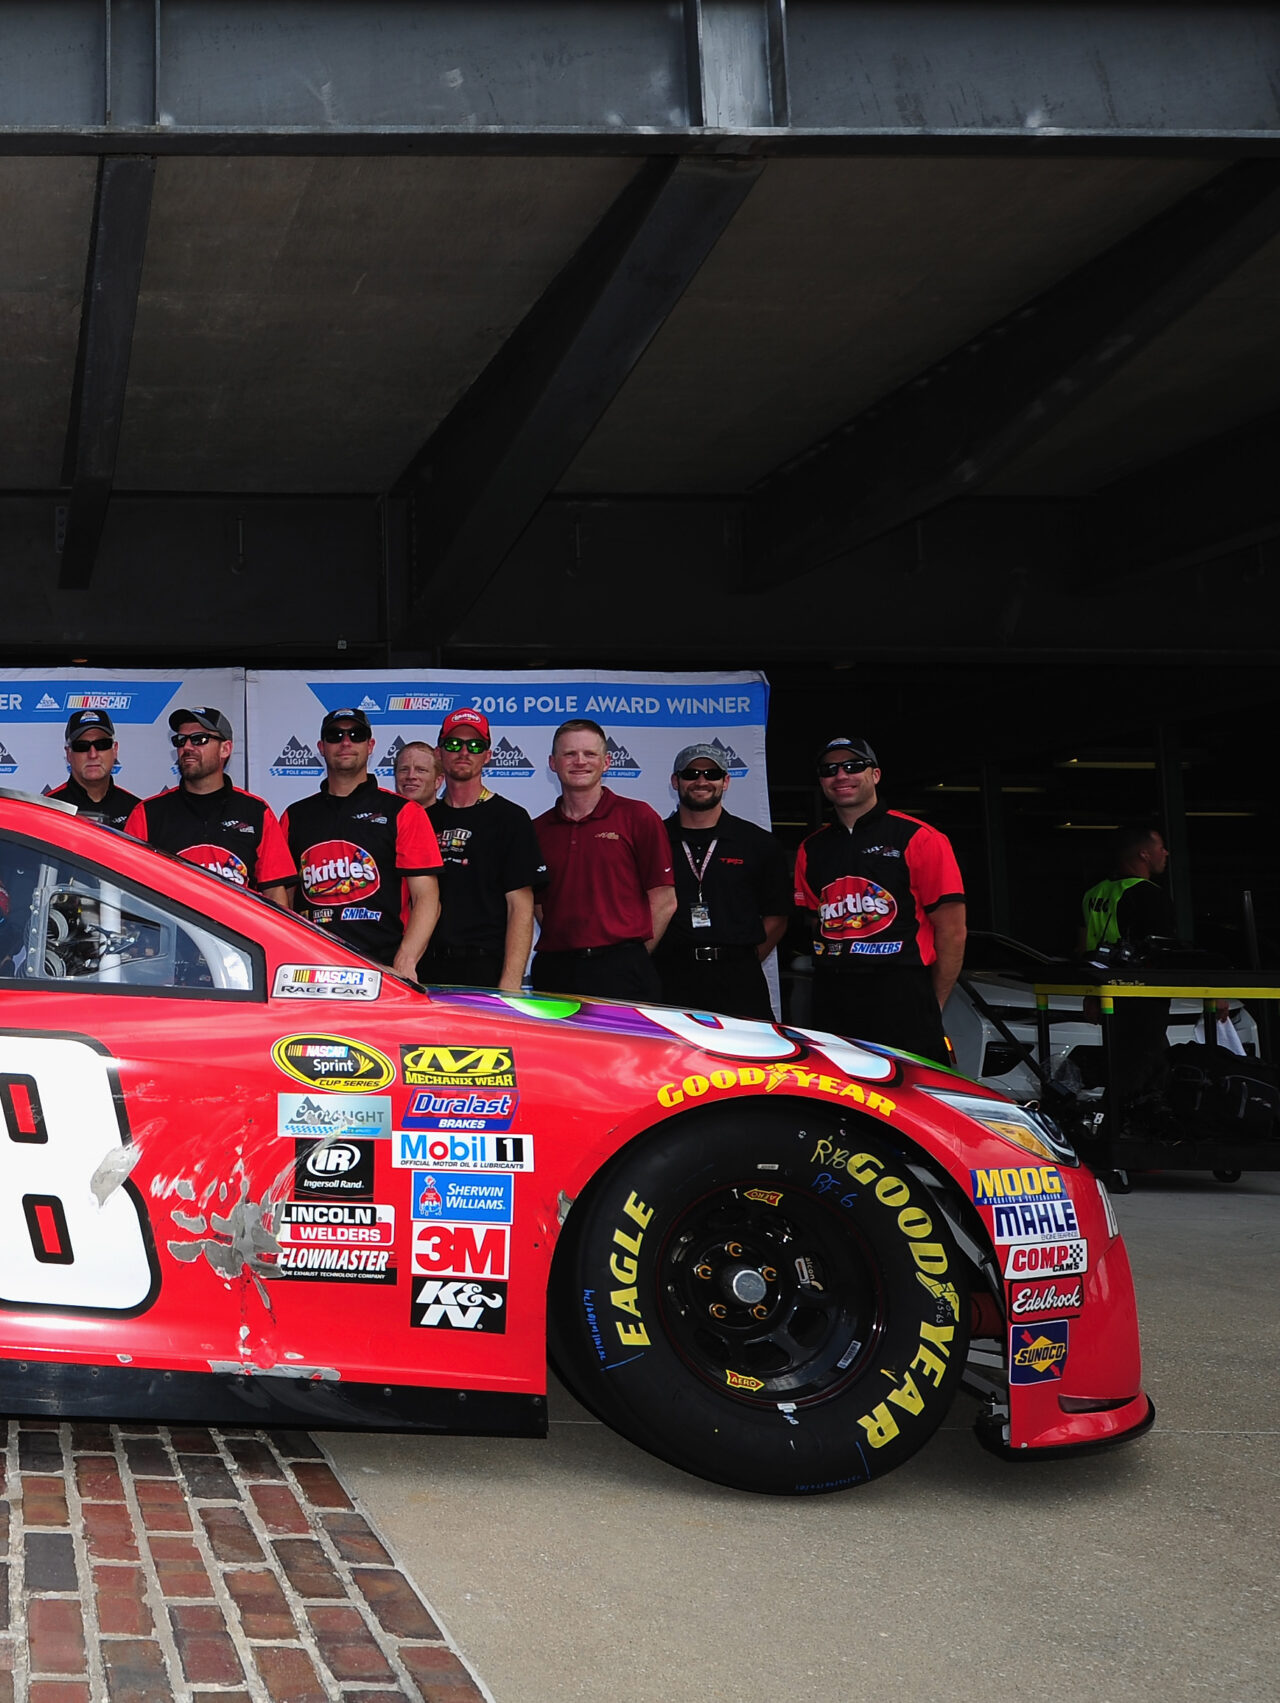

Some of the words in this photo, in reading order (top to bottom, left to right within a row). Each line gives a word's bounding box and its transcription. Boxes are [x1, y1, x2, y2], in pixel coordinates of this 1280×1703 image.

[88, 696, 130, 709] NASCAR
[409, 697, 451, 710] NASCAR
[471, 696, 517, 713] 2016
[524, 696, 578, 712] POLE
[585, 696, 660, 714] AWARD
[667, 697, 751, 714] WINNER
[279, 743, 314, 758] Coors
[606, 749, 631, 760] oors
[285, 758, 309, 766] LIGHT
[495, 759, 520, 767] LIGHT
[303, 857, 375, 889] Skittles
[852, 943, 901, 953] SNICKERS
[312, 970, 363, 985] NASCAR
[281, 985, 327, 994] RACE
[329, 987, 368, 996] CAR
[305, 1045, 347, 1057] NASCAR
[313, 1059, 353, 1074] Sprint
[405, 1071, 473, 1085] MECHANIX
[475, 1074, 514, 1086] WEAR
[657, 1063, 897, 1117] GOODYEAR
[412, 1093, 512, 1115] Duralast
[438, 1119, 486, 1129] BRAKES
[1093, 1112, 1105, 1124] 8
[401, 1134, 486, 1161] Mobil
[502, 1138, 514, 1162] 1
[315, 1149, 352, 1171] IR
[303, 1179, 339, 1189] Ingersoll
[340, 1180, 362, 1189] Rand
[976, 1166, 1062, 1198] MOOG
[447, 1183, 504, 1197] SHERWIN
[446, 1196, 504, 1210] WILLIAMS
[280, 1206, 372, 1224] LINCOLN
[994, 1202, 1077, 1237] MAHLE
[299, 1226, 381, 1241] WELDERS
[415, 1225, 506, 1275] 3M
[277, 1247, 390, 1271] FLOWMASTER
[1012, 1246, 1069, 1272] COMP
[609, 1190, 655, 1346] EAGLE
[805, 1256, 815, 1280] alcon
[1052, 1262, 1079, 1273] CAMS
[848, 1152, 960, 1450] GOODYEAR
[1012, 1284, 1081, 1314] Edelbrock
[1017, 1342, 1065, 1364] SUNOCO
[730, 1376, 757, 1387] AERO
